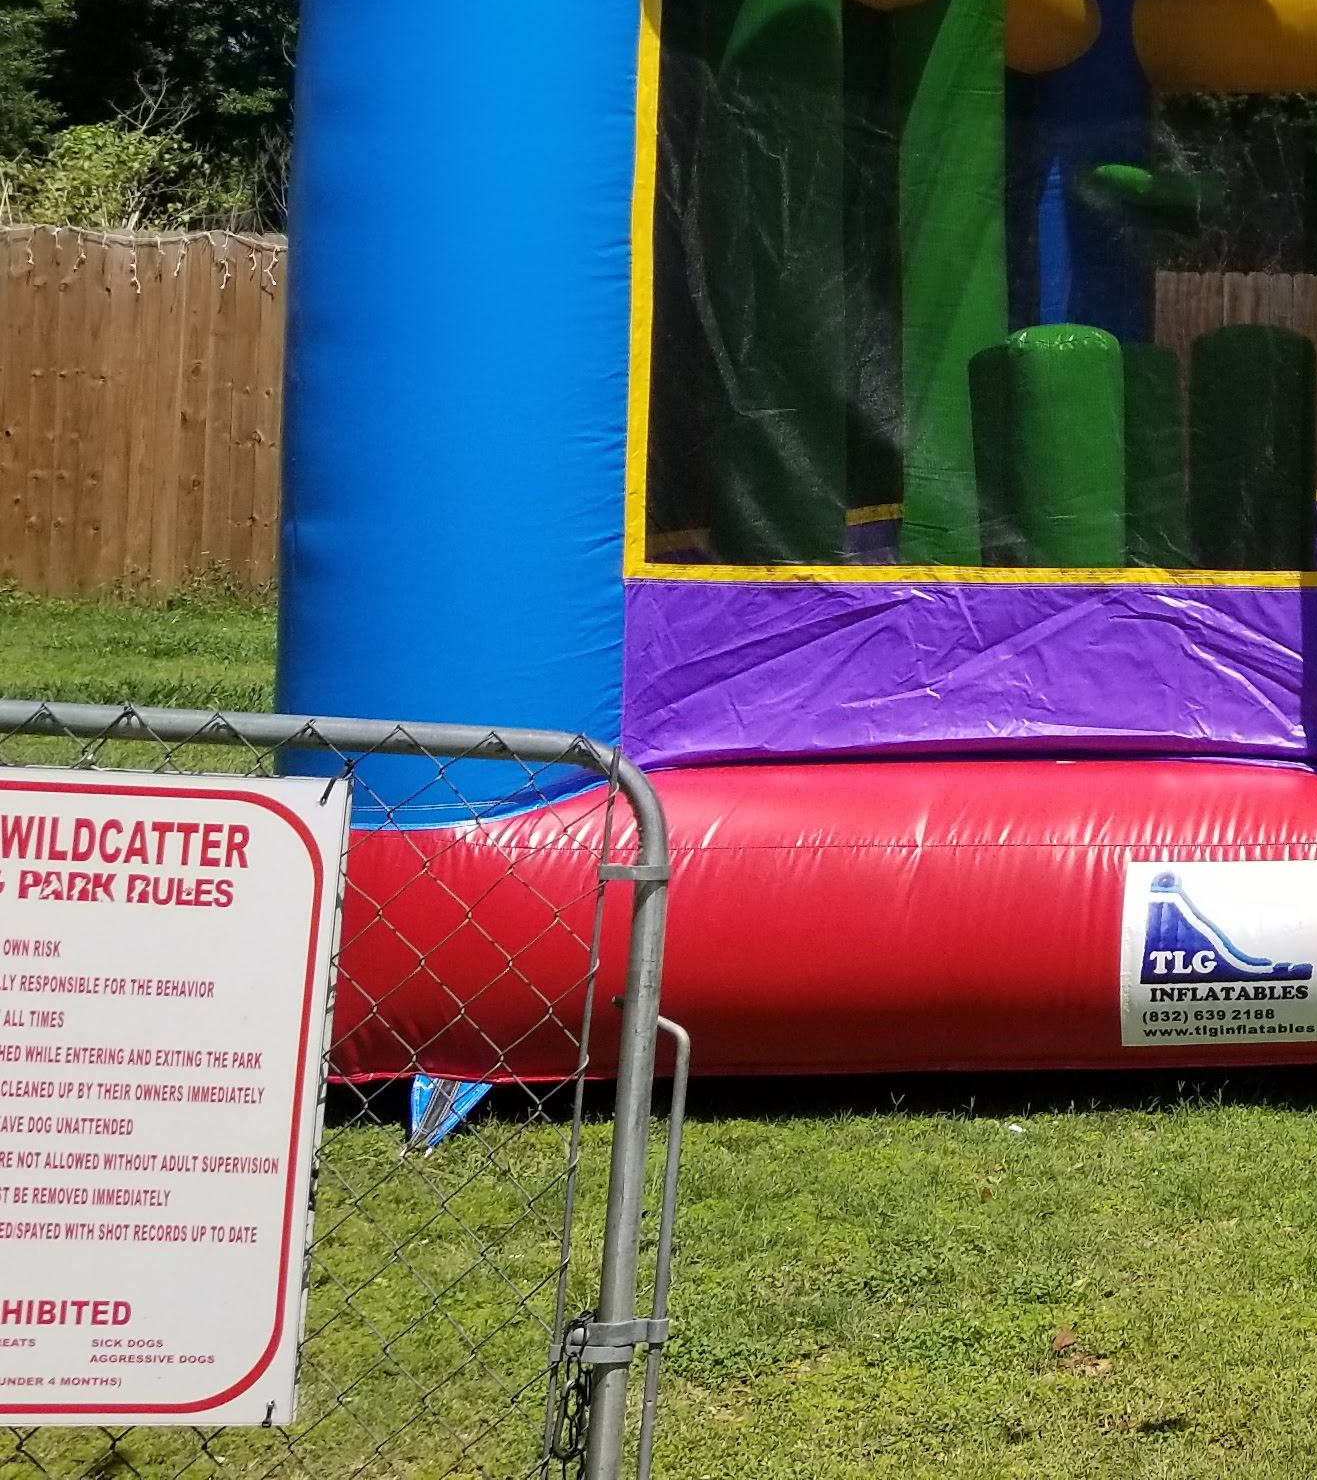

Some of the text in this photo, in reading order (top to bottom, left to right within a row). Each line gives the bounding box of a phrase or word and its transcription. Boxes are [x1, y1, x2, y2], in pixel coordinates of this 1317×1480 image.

[1, 815, 250, 868] WILDCATTER
[18, 870, 234, 907] PARK RULES
[3, 938, 61, 957] OWN RISK
[1149, 950, 1218, 975] TLG
[20, 975, 100, 994] RESPONSIBLE
[104, 978, 126, 994] FOR
[131, 979, 152, 995] THE
[156, 980, 215, 998] BEHAVIOR
[1149, 985, 1309, 1003] INFLATABLES
[3, 1009, 64, 1028] ALL TIMES
[1142, 1008, 1276, 1025] (832) 639 2188
[25, 1045, 61, 1063] WHILE
[65, 1047, 125, 1065] ENTERING
[127, 1048, 151, 1066] AND
[155, 1050, 202, 1067] EXITING
[207, 1051, 228, 1068] THE
[232, 1052, 262, 1069] PARK
[1, 1080, 265, 1104] CLEANED UP BY THEIR OWNERS IMMEDIATELY
[0, 1115, 134, 1135] AVE DOG UNATTENDED
[17, 1151, 41, 1169] NOT
[44, 1152, 100, 1170] ALLOWED
[103, 1153, 158, 1171] WITHOUT
[160, 1154, 199, 1172] ADULT
[201, 1156, 279, 1174] SUPERVISION
[13, 1187, 29, 1204] BE
[32, 1187, 88, 1205] REMOVED
[92, 1188, 171, 1207] IMMEDIATELY
[65, 1223, 95, 1240] WITH
[98, 1224, 130, 1241] SHOT
[133, 1224, 188, 1242] RECORDS
[191, 1225, 207, 1242] UP
[210, 1225, 225, 1243] TO
[228, 1226, 258, 1244] DATE
[1, 1299, 132, 1326] HIBITED
[91, 1338, 123, 1348] SICK
[127, 1339, 164, 1349] DOGS
[90, 1354, 215, 1364] AGGRESSIVE DOGS
[48, 1377, 56, 1386] 4
[60, 1377, 122, 1388] MONTHS)
